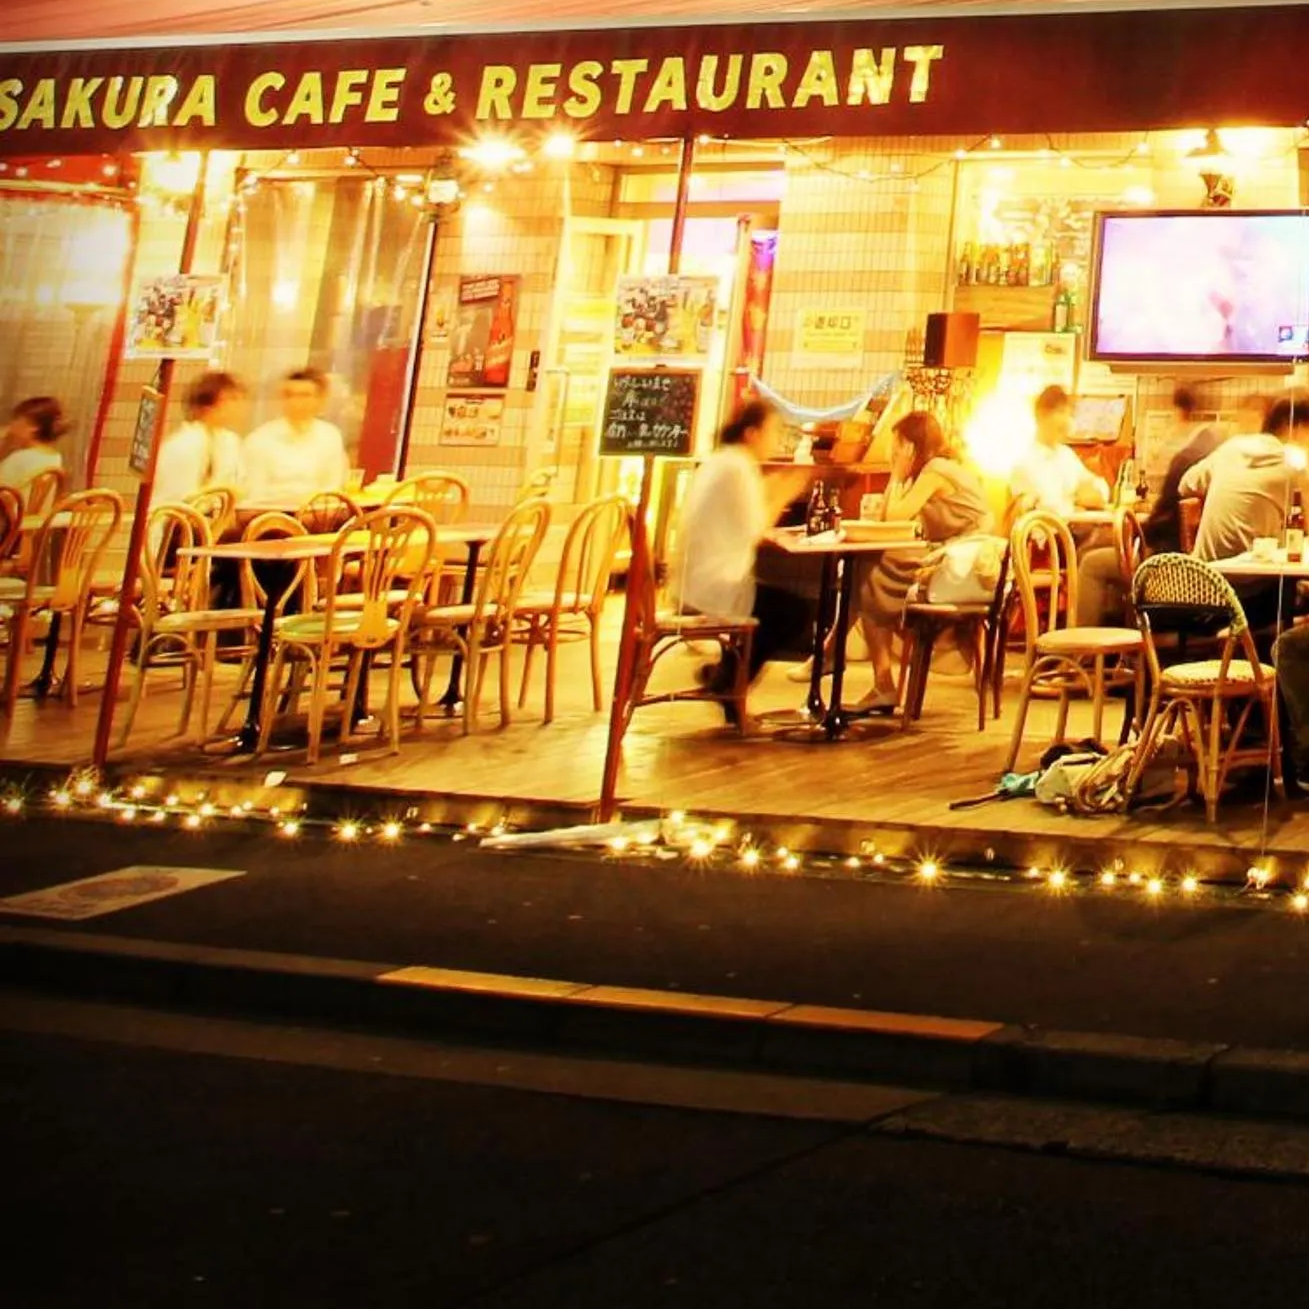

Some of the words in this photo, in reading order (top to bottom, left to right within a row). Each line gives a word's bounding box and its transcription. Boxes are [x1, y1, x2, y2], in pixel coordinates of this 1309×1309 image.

[0, 74, 216, 131] SAKURA
[244, 67, 407, 128] CAFE
[423, 72, 457, 116] &
[475, 44, 944, 120] RESTAURANT
